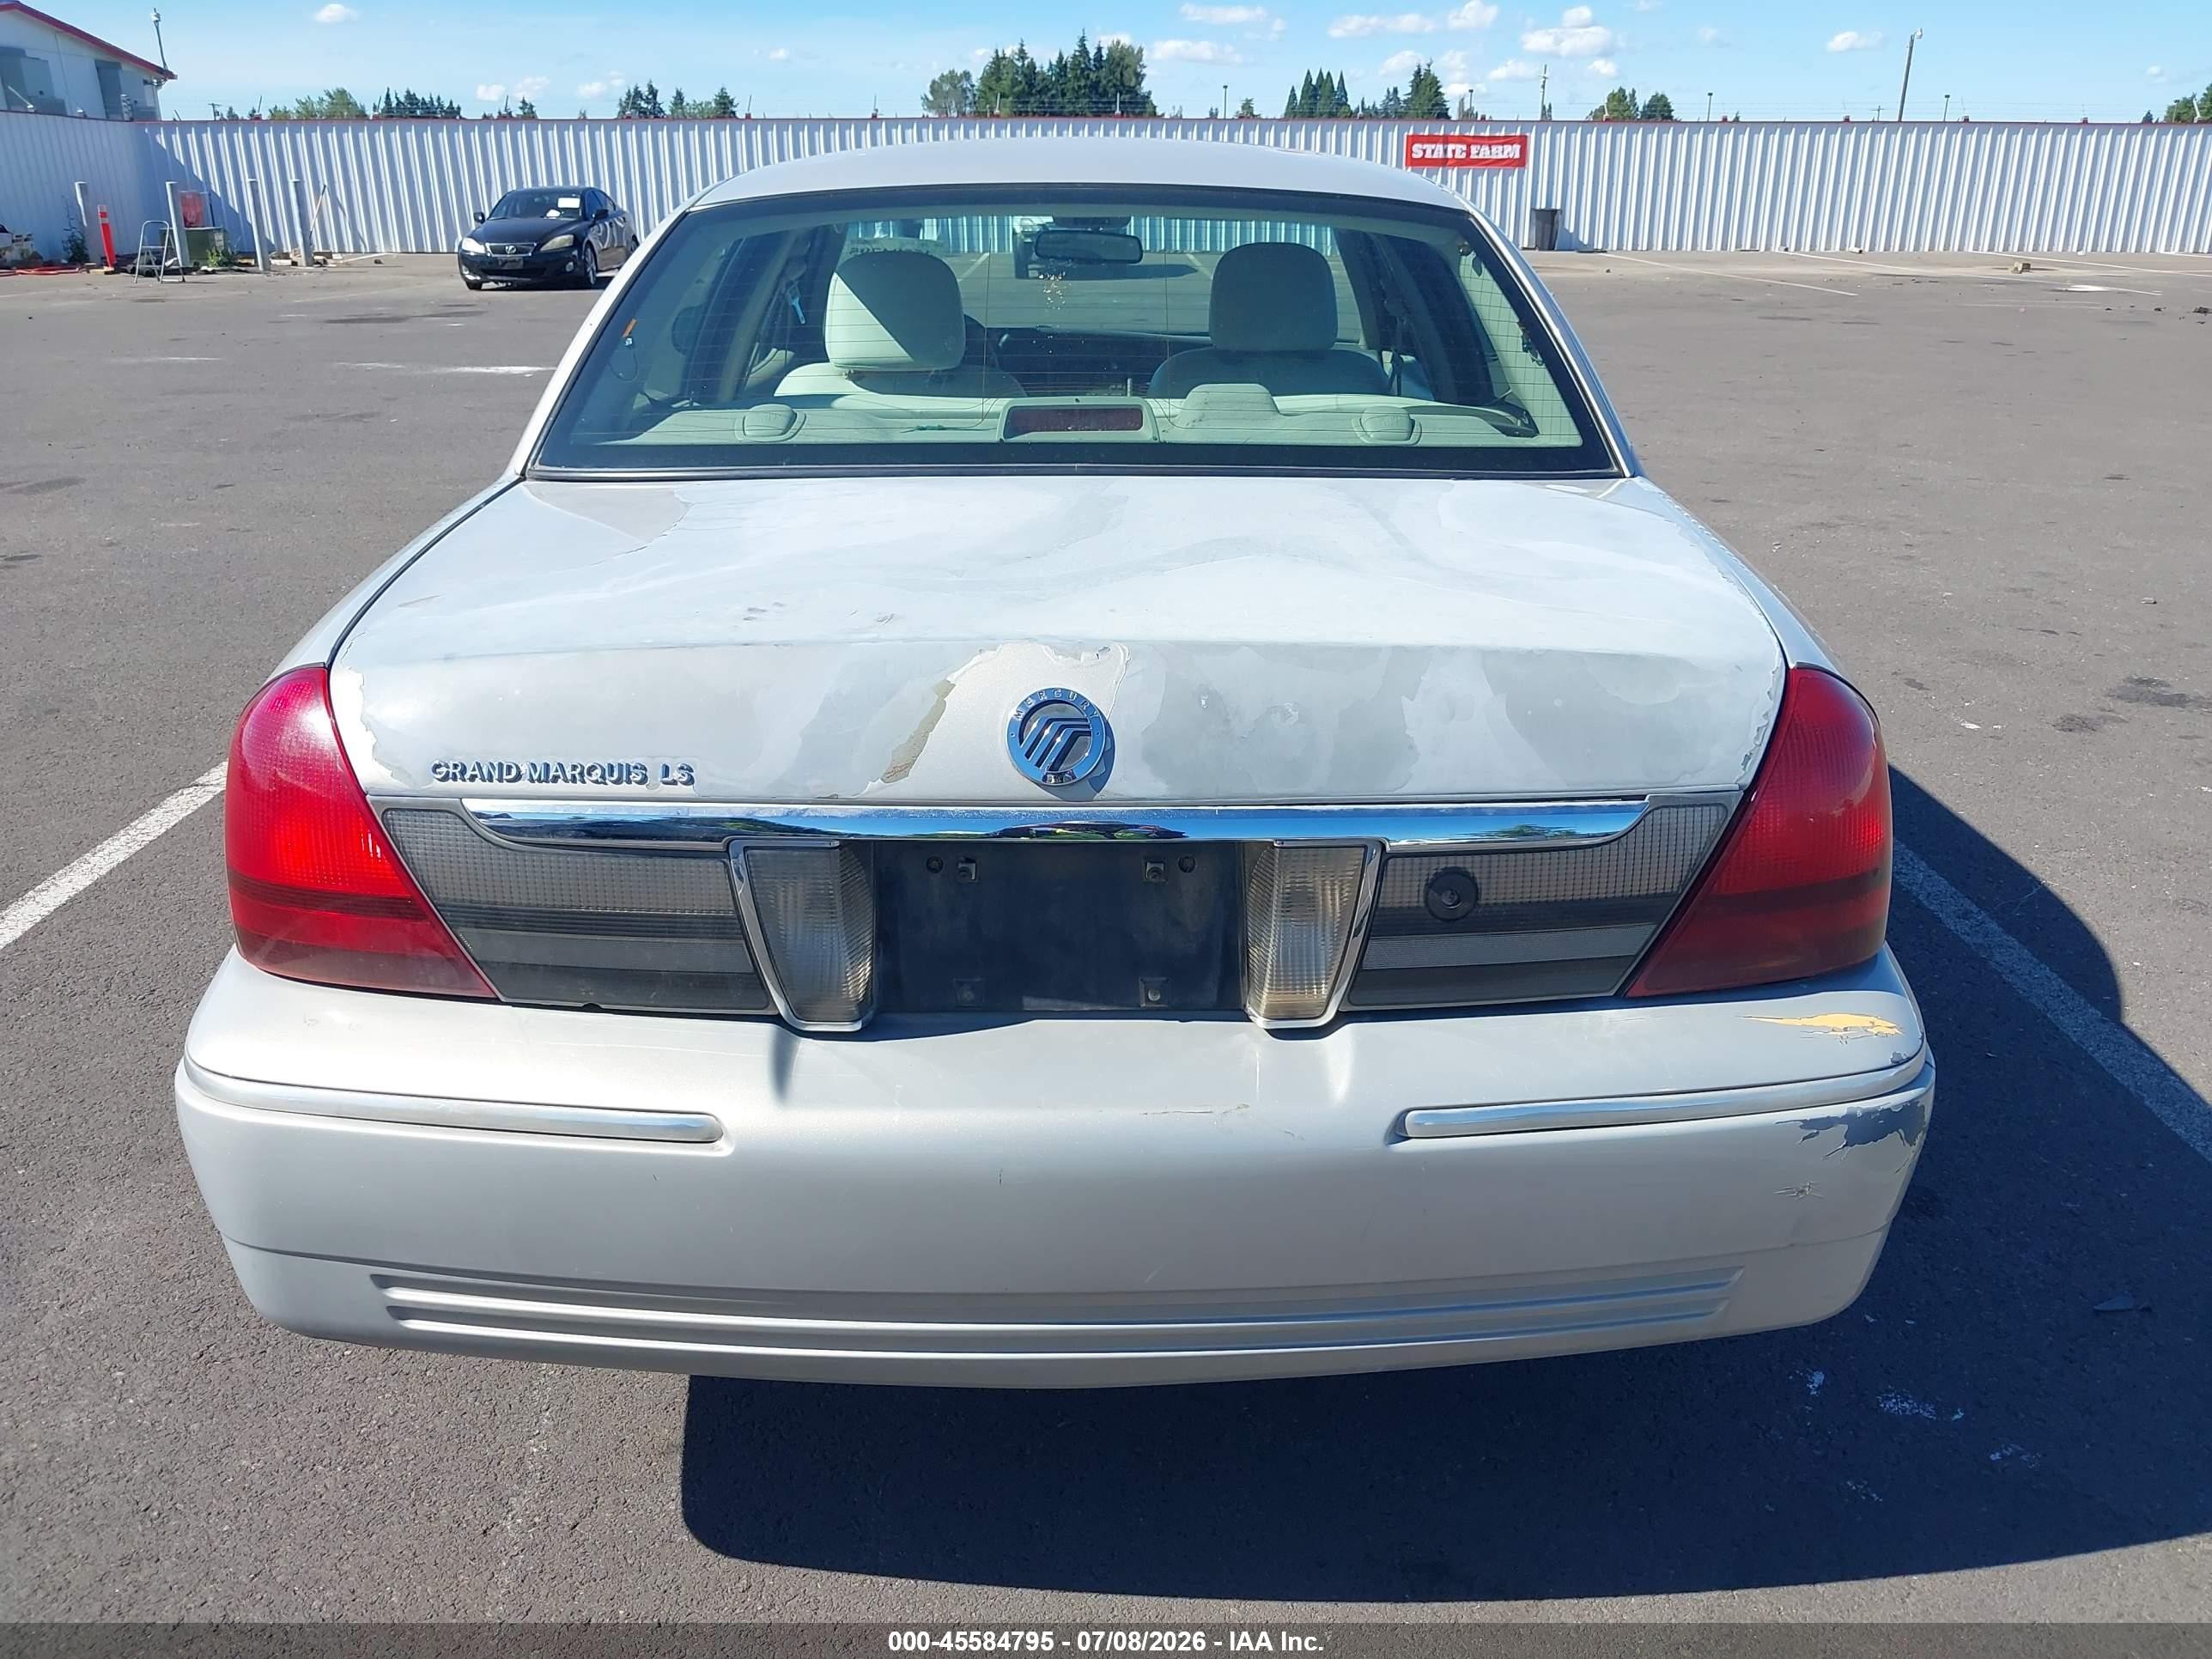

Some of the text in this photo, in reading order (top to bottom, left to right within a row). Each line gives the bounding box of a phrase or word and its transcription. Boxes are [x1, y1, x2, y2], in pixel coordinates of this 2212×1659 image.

[1412, 143, 1522, 160] STATE FARM
[1013, 689, 1099, 721] MERCURY
[431, 760, 696, 786] GRAND MARQUIS LS
